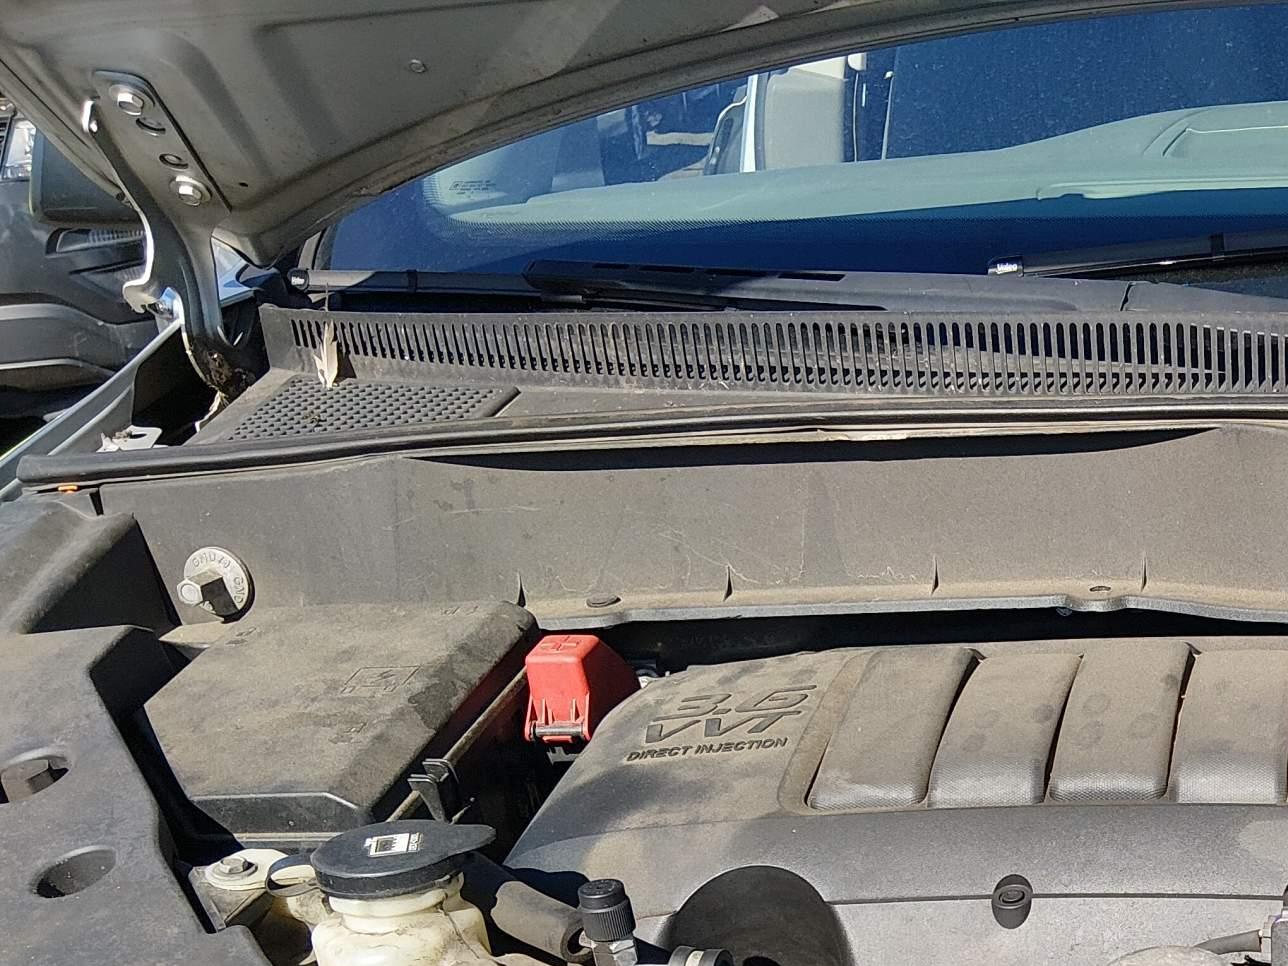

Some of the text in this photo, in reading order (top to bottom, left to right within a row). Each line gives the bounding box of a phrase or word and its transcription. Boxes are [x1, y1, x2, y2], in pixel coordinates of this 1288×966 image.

[645, 710, 801, 743] VVT
[626, 737, 789, 762] DIRECT INJECTION
